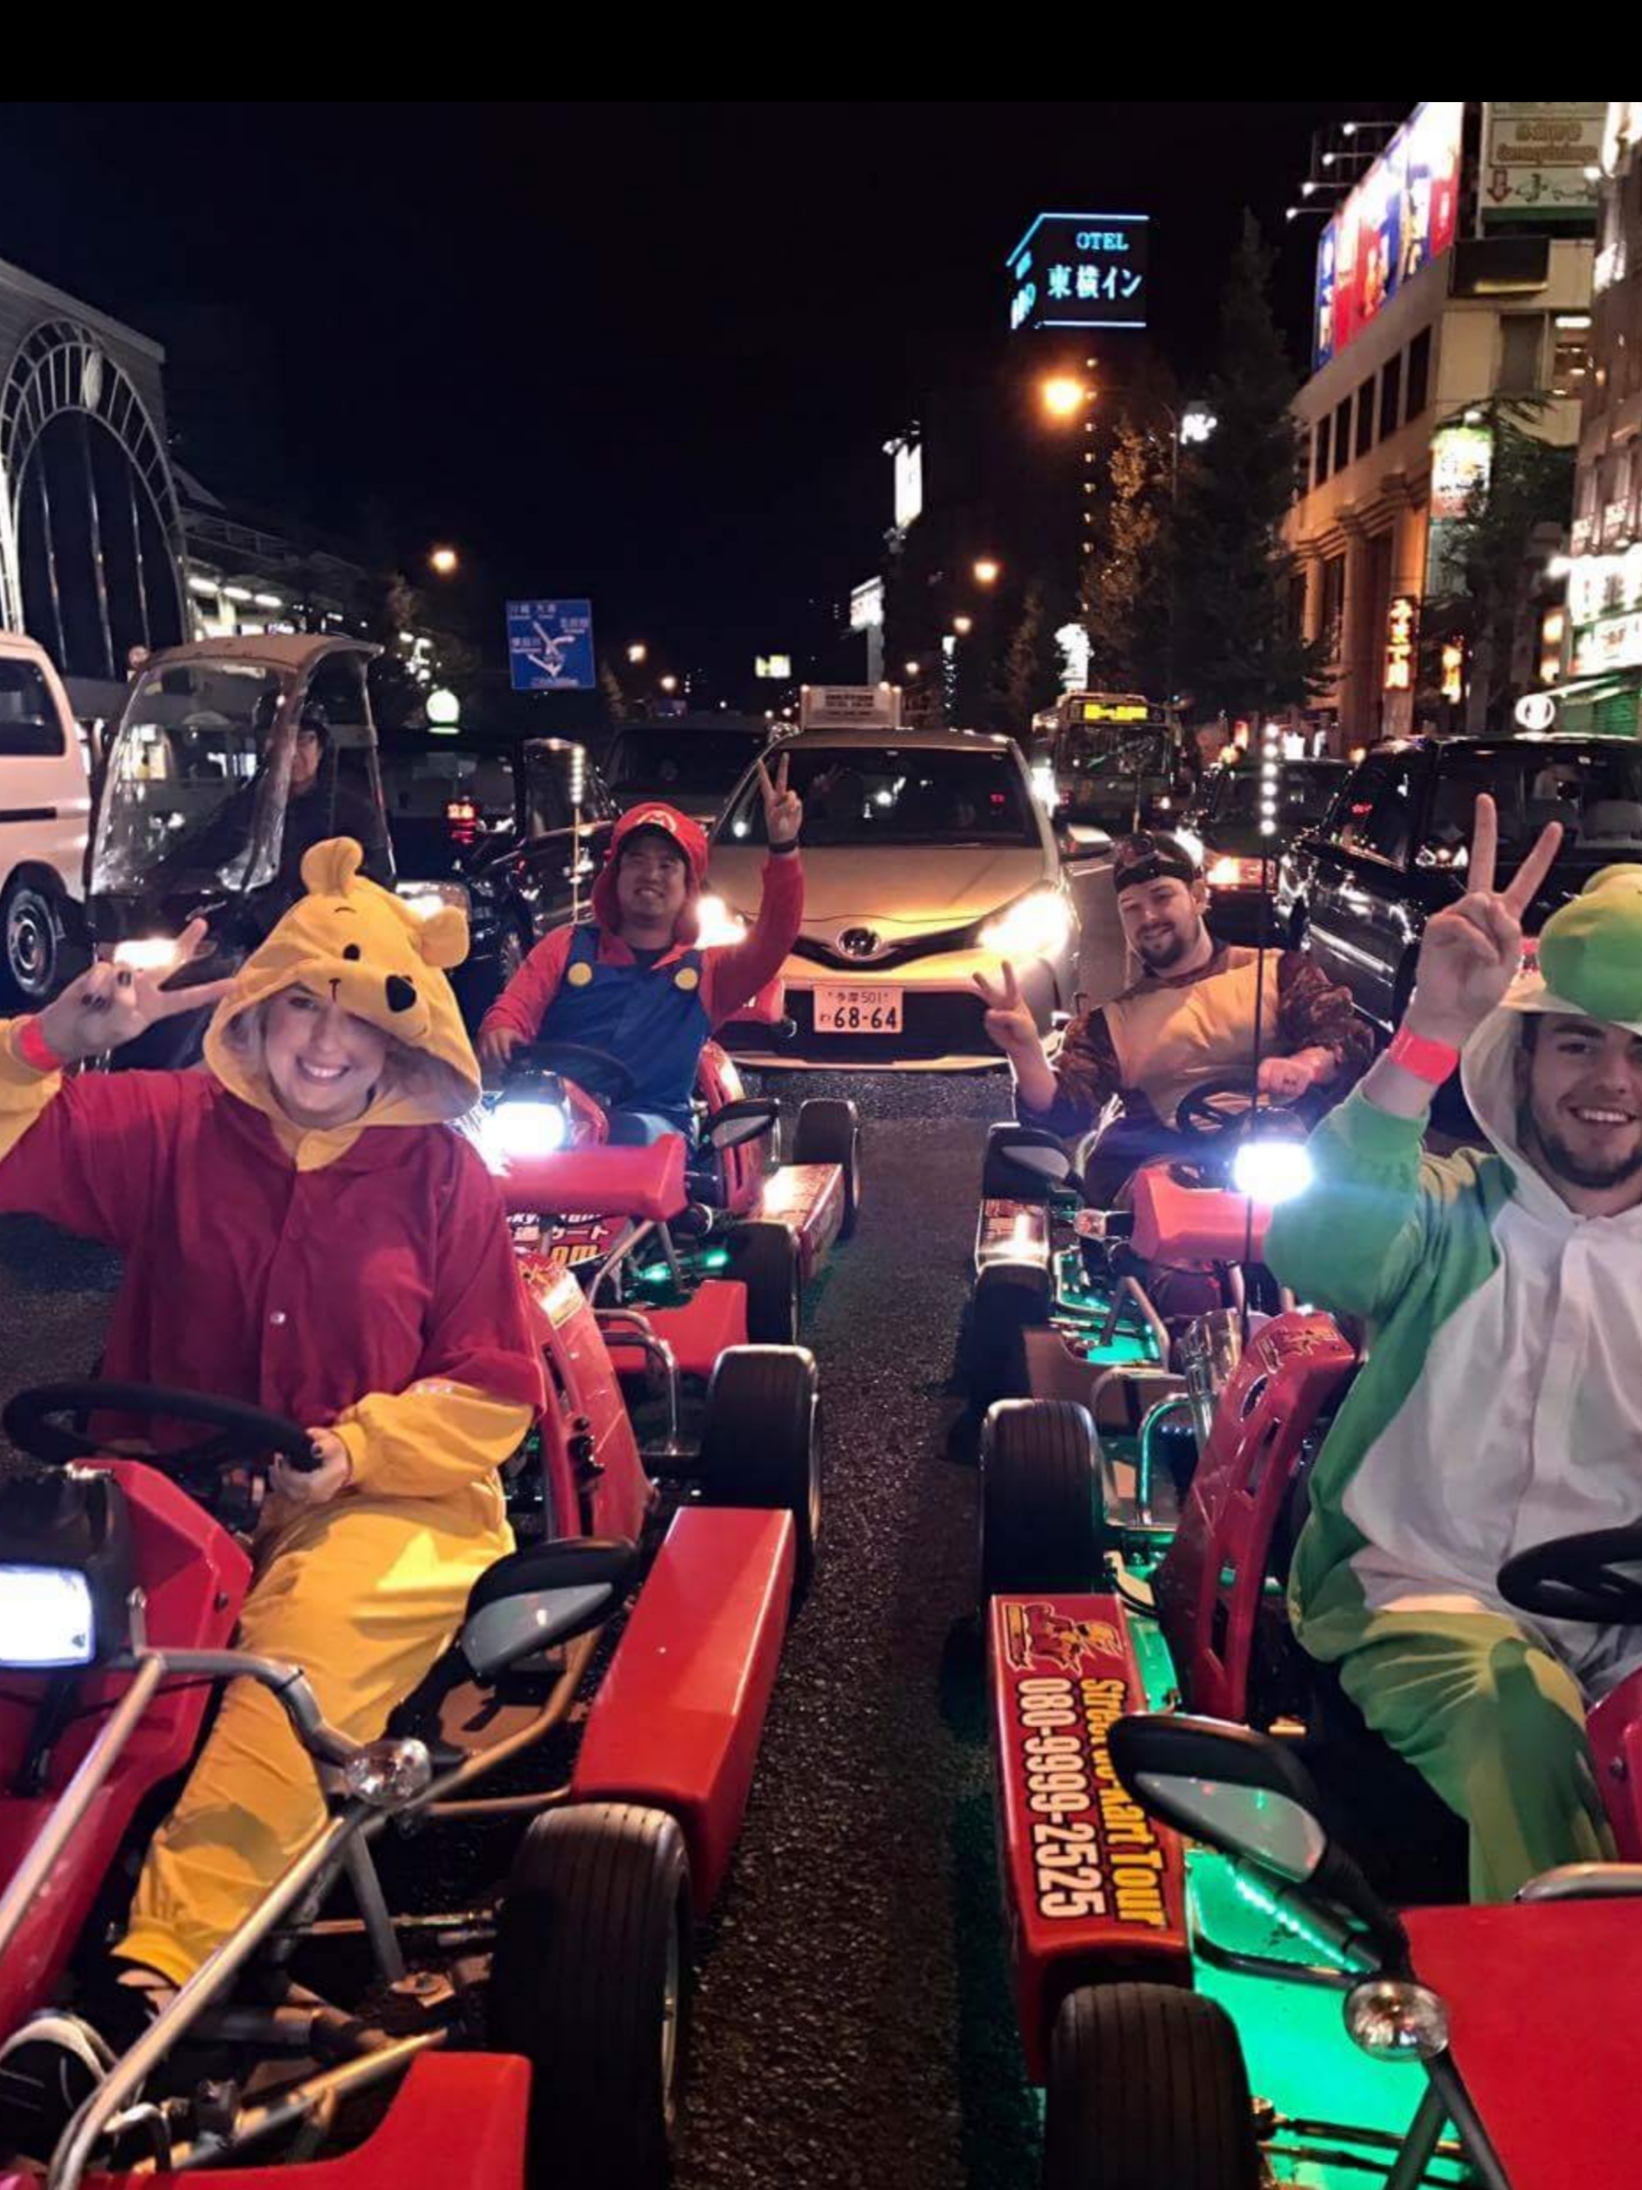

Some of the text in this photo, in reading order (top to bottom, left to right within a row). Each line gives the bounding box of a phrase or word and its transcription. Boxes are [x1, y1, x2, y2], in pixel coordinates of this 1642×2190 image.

[834, 1006, 897, 1029] 68-64
[861, 992, 882, 1003] 501
[1017, 1677, 1106, 1919] 080-9999-2525
[1111, 1849, 1167, 1930] Tour
